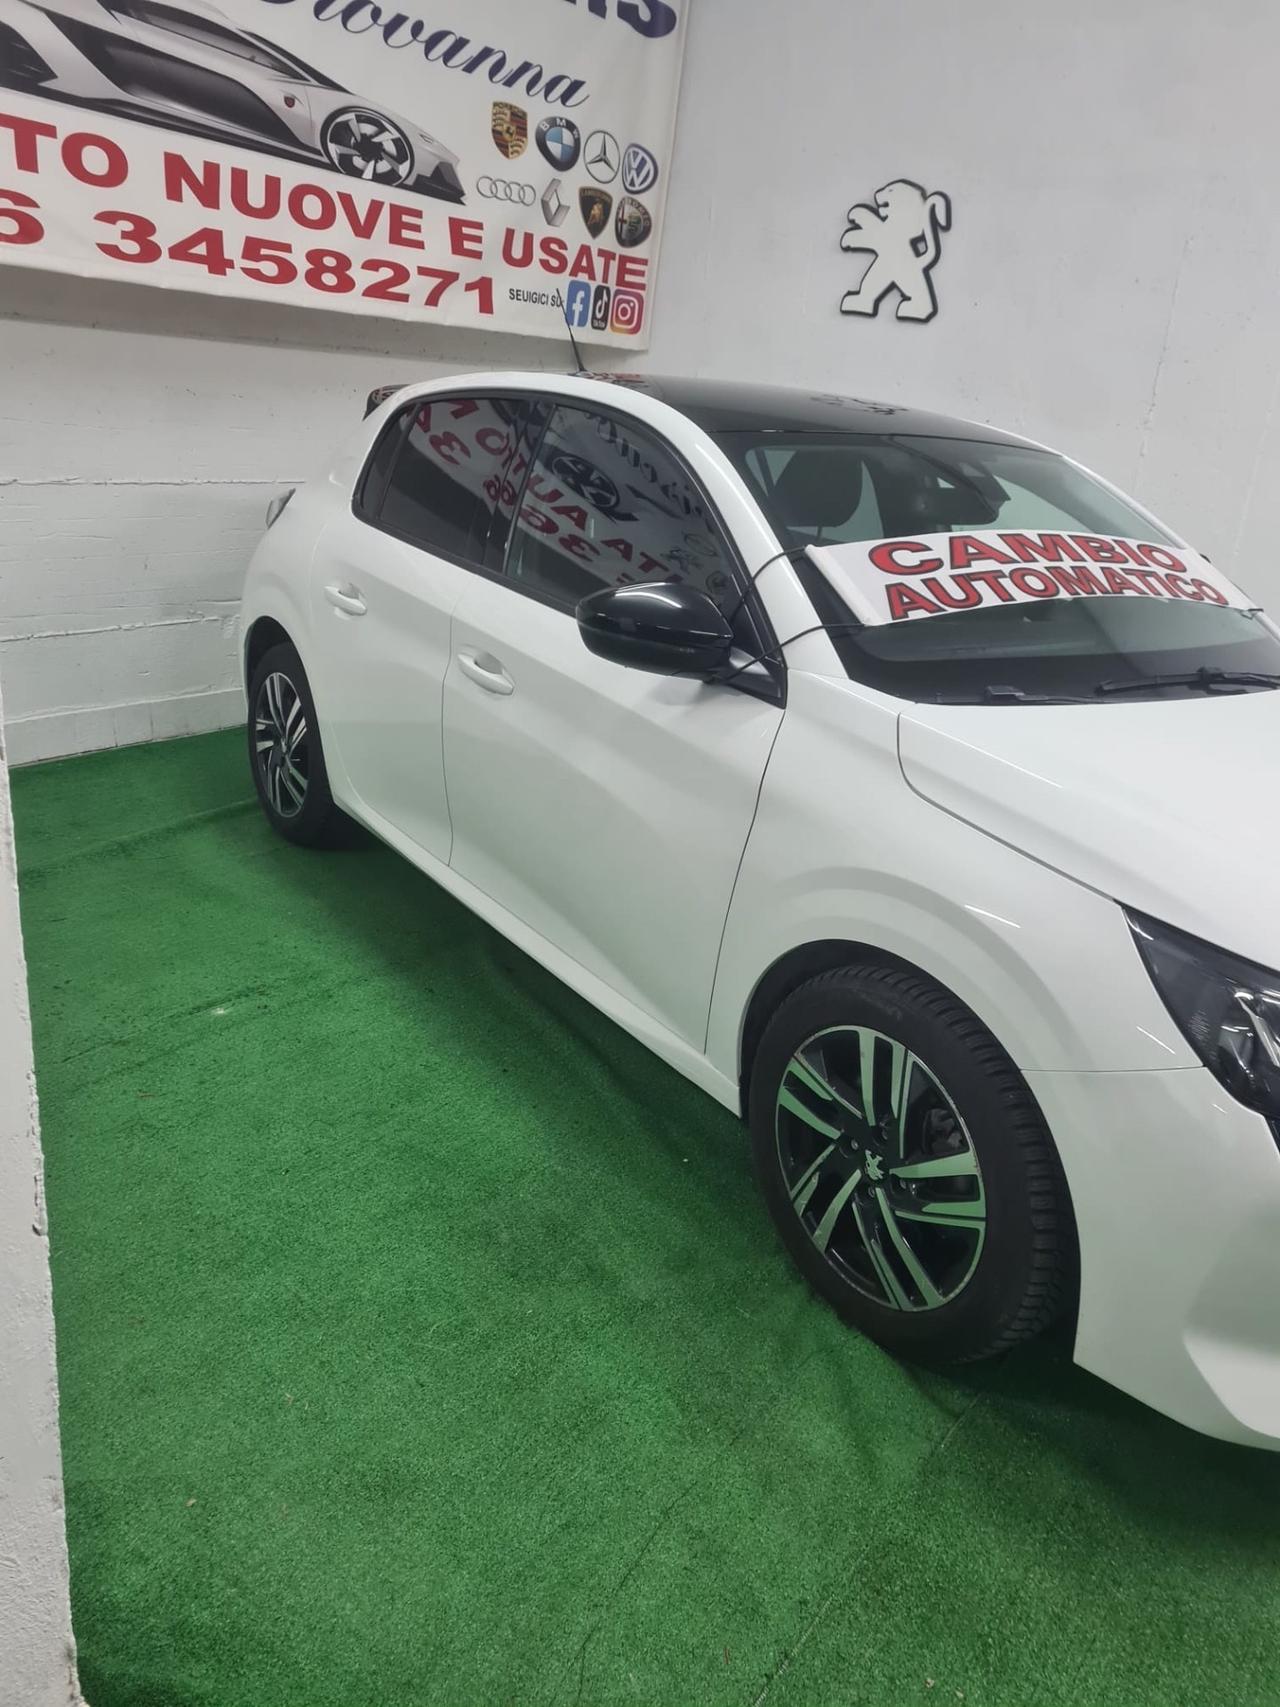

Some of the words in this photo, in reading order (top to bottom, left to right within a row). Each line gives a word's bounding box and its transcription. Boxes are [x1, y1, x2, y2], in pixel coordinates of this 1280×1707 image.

[260, 0, 589, 107] iovanna
[164, 152, 424, 251] NUOVE
[448, 218, 482, 260] E
[502, 228, 648, 291] USATE
[96, 210, 493, 316] 3458271
[508, 288, 549, 306] SEUIGICI
[869, 533, 1188, 576] CAMBIO
[885, 566, 1229, 620] AUTOMATICO
